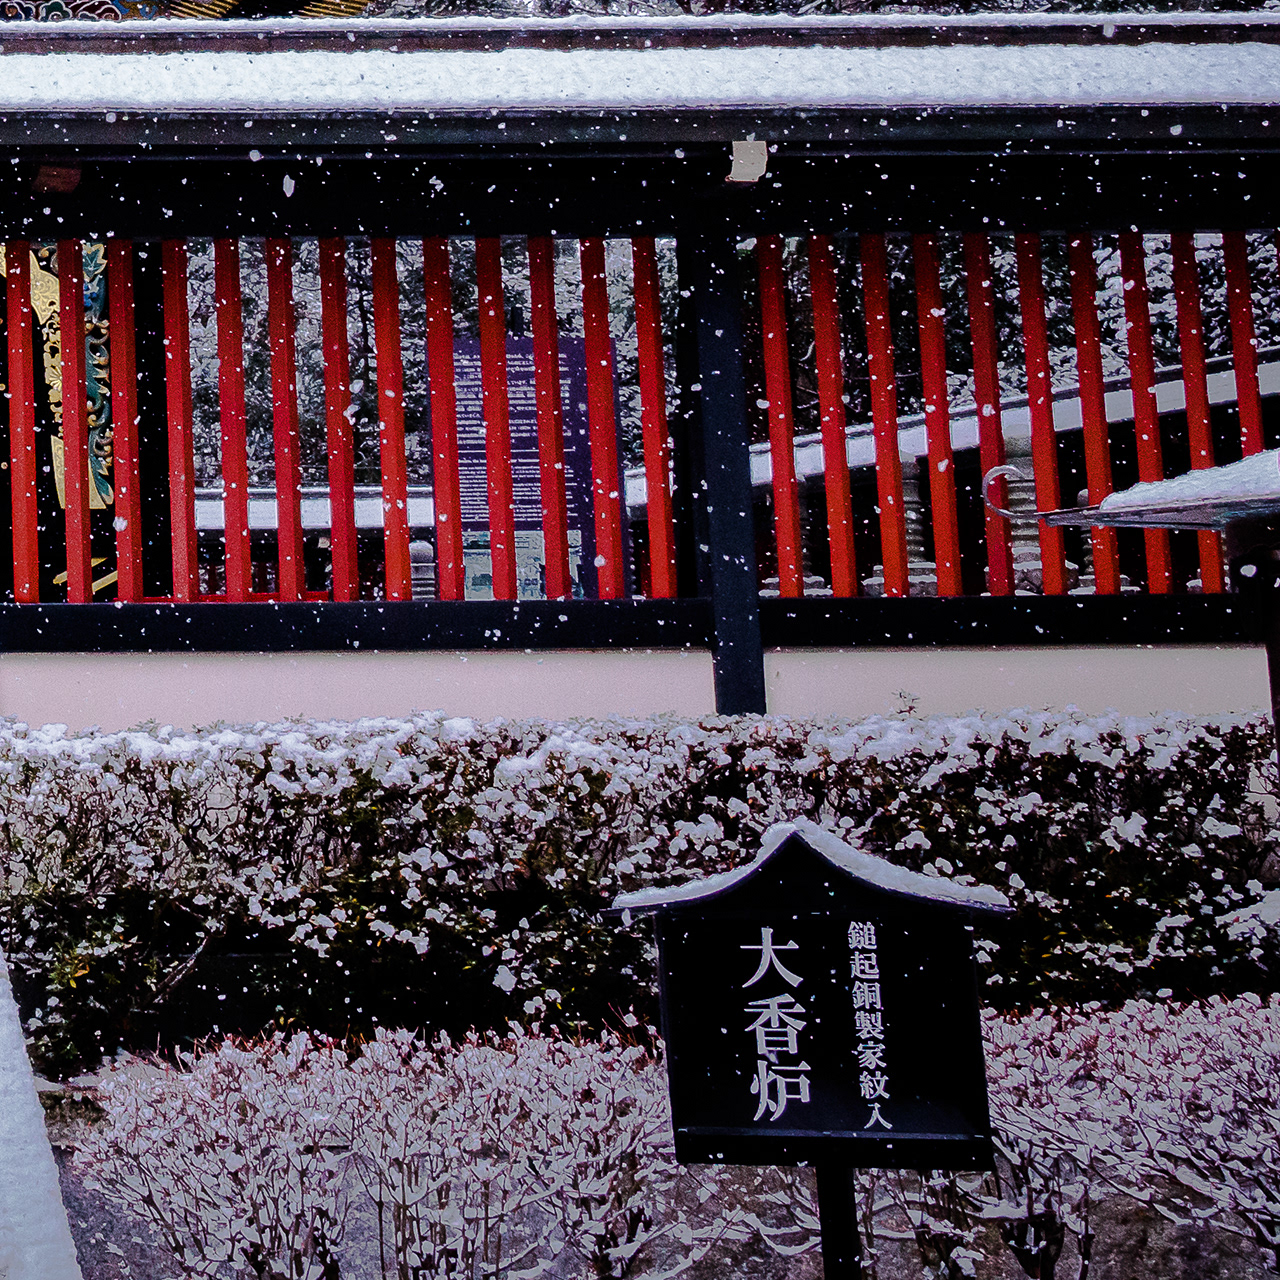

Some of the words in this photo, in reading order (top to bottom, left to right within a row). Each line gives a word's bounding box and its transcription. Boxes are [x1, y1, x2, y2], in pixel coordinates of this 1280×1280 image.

[740, 926, 811, 1121] 大香炉
[847, 920, 893, 1130] 鎚起銅製家紋入
